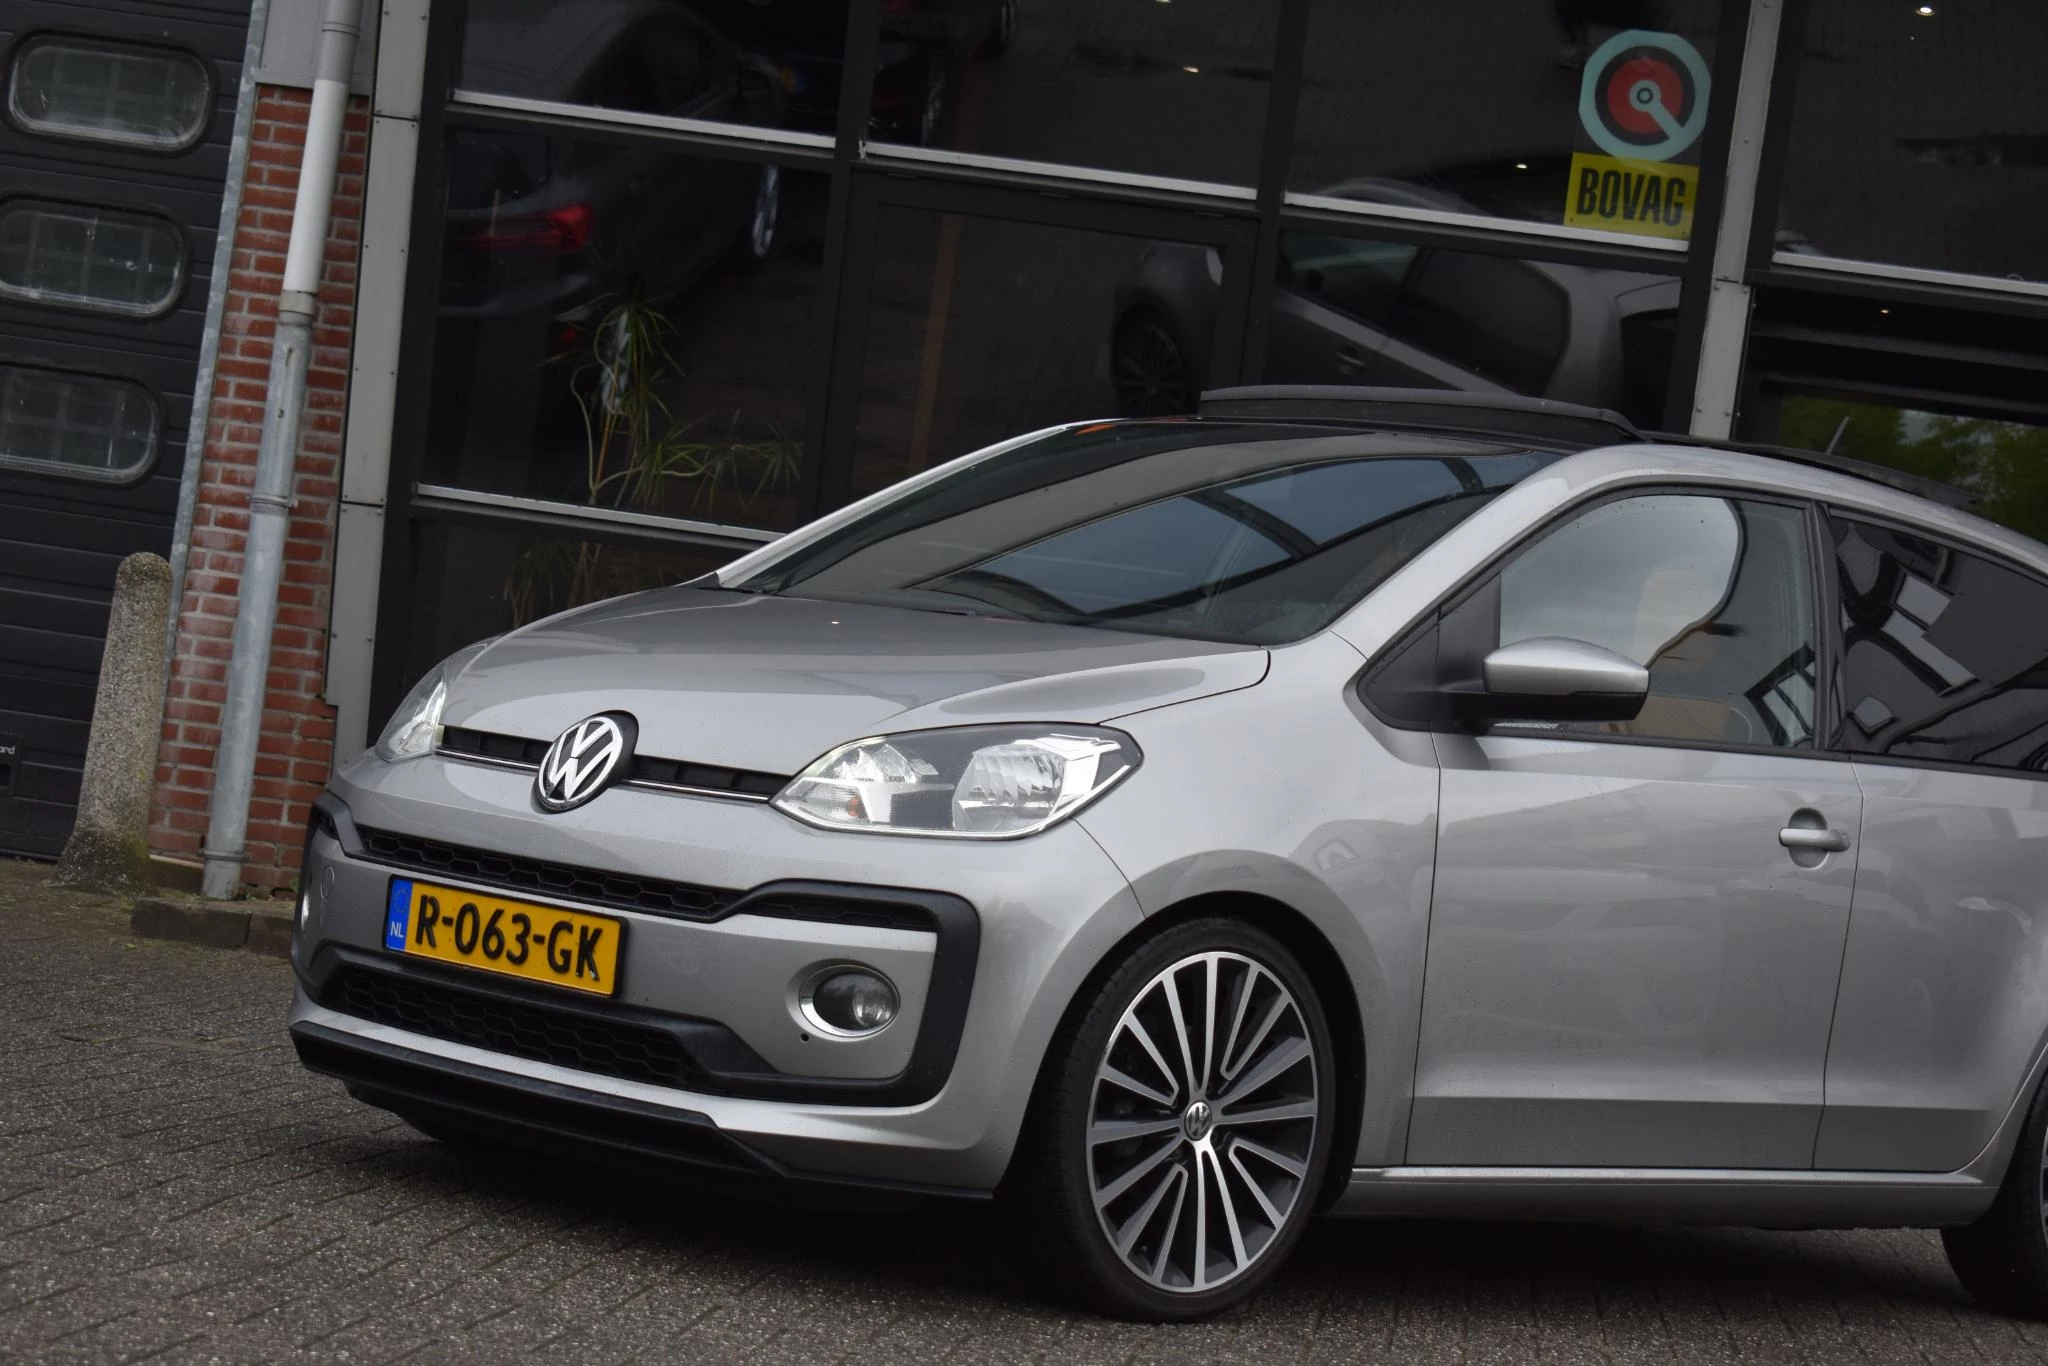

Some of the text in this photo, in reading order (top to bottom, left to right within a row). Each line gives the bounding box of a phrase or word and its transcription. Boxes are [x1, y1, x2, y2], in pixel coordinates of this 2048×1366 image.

[1576, 167, 1686, 226] BOVAG
[390, 921, 405, 939] NL
[415, 894, 604, 982] R-063-GK
